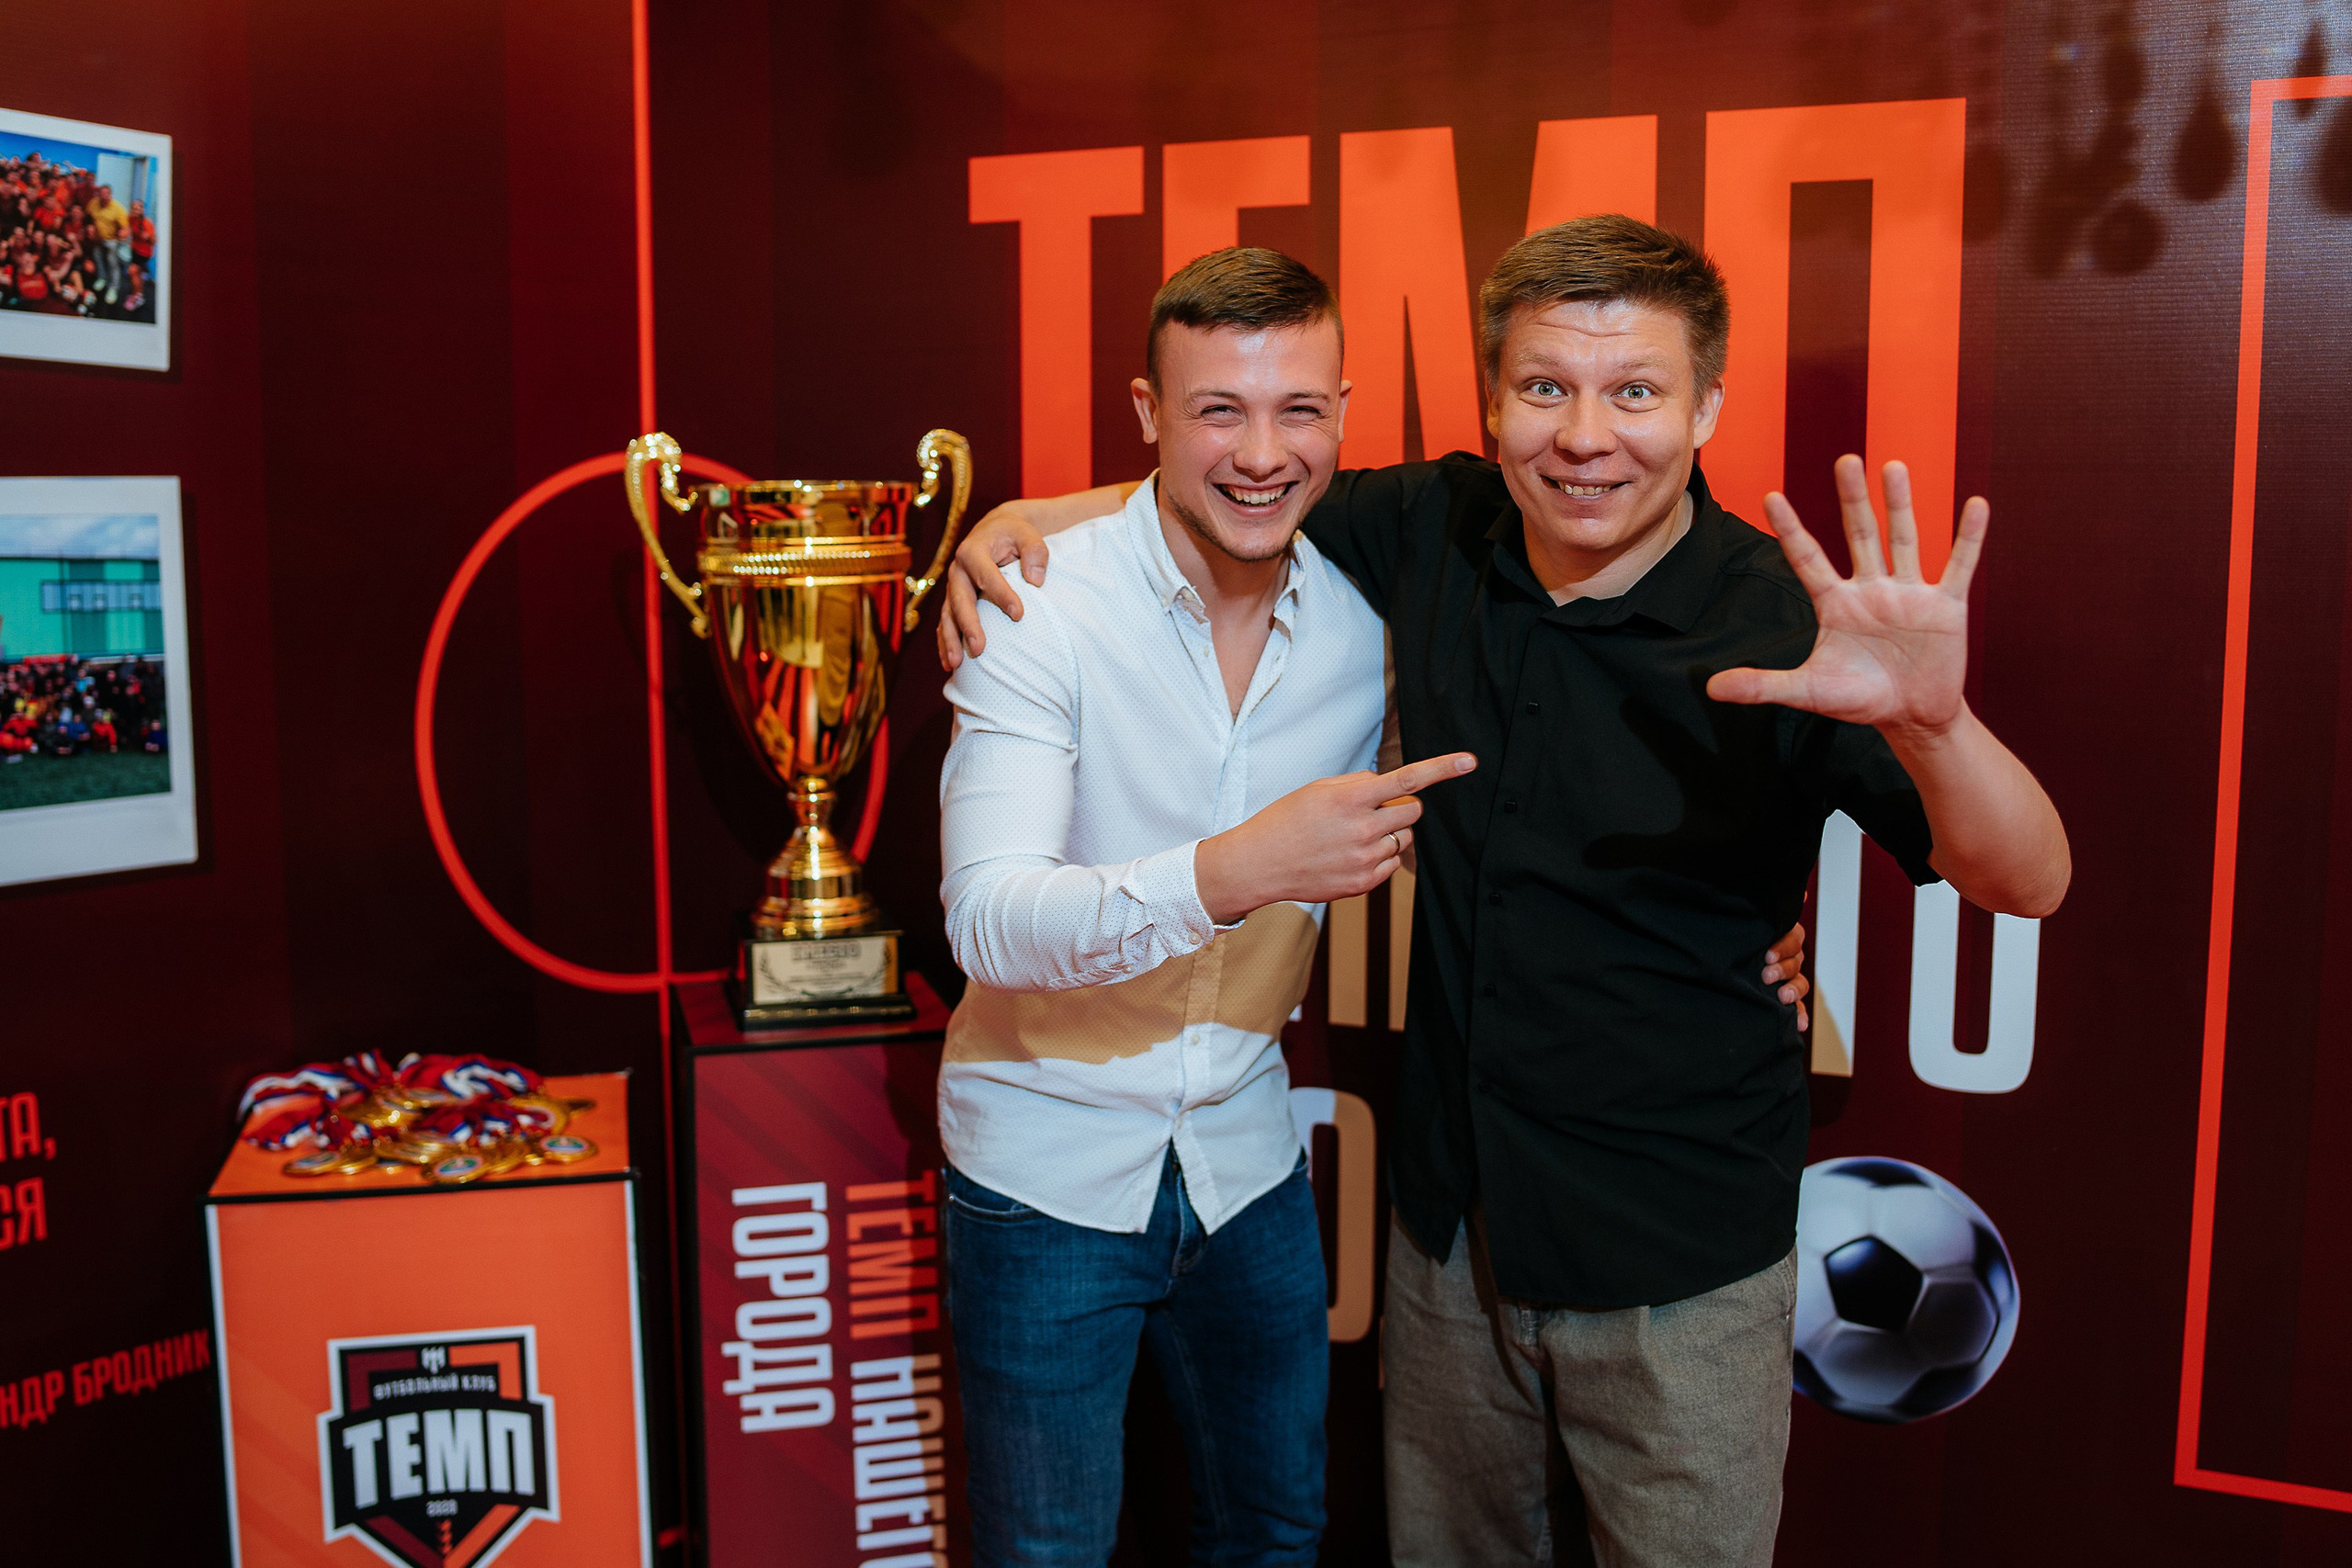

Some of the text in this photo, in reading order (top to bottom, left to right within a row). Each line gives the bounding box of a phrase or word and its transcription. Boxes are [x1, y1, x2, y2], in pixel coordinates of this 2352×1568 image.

[721, 1181, 836, 1434] ГОРОДА
[845, 1169, 949, 1568] ТЕМП НАШЕГ
[343, 1409, 536, 1510] ТЕМП
